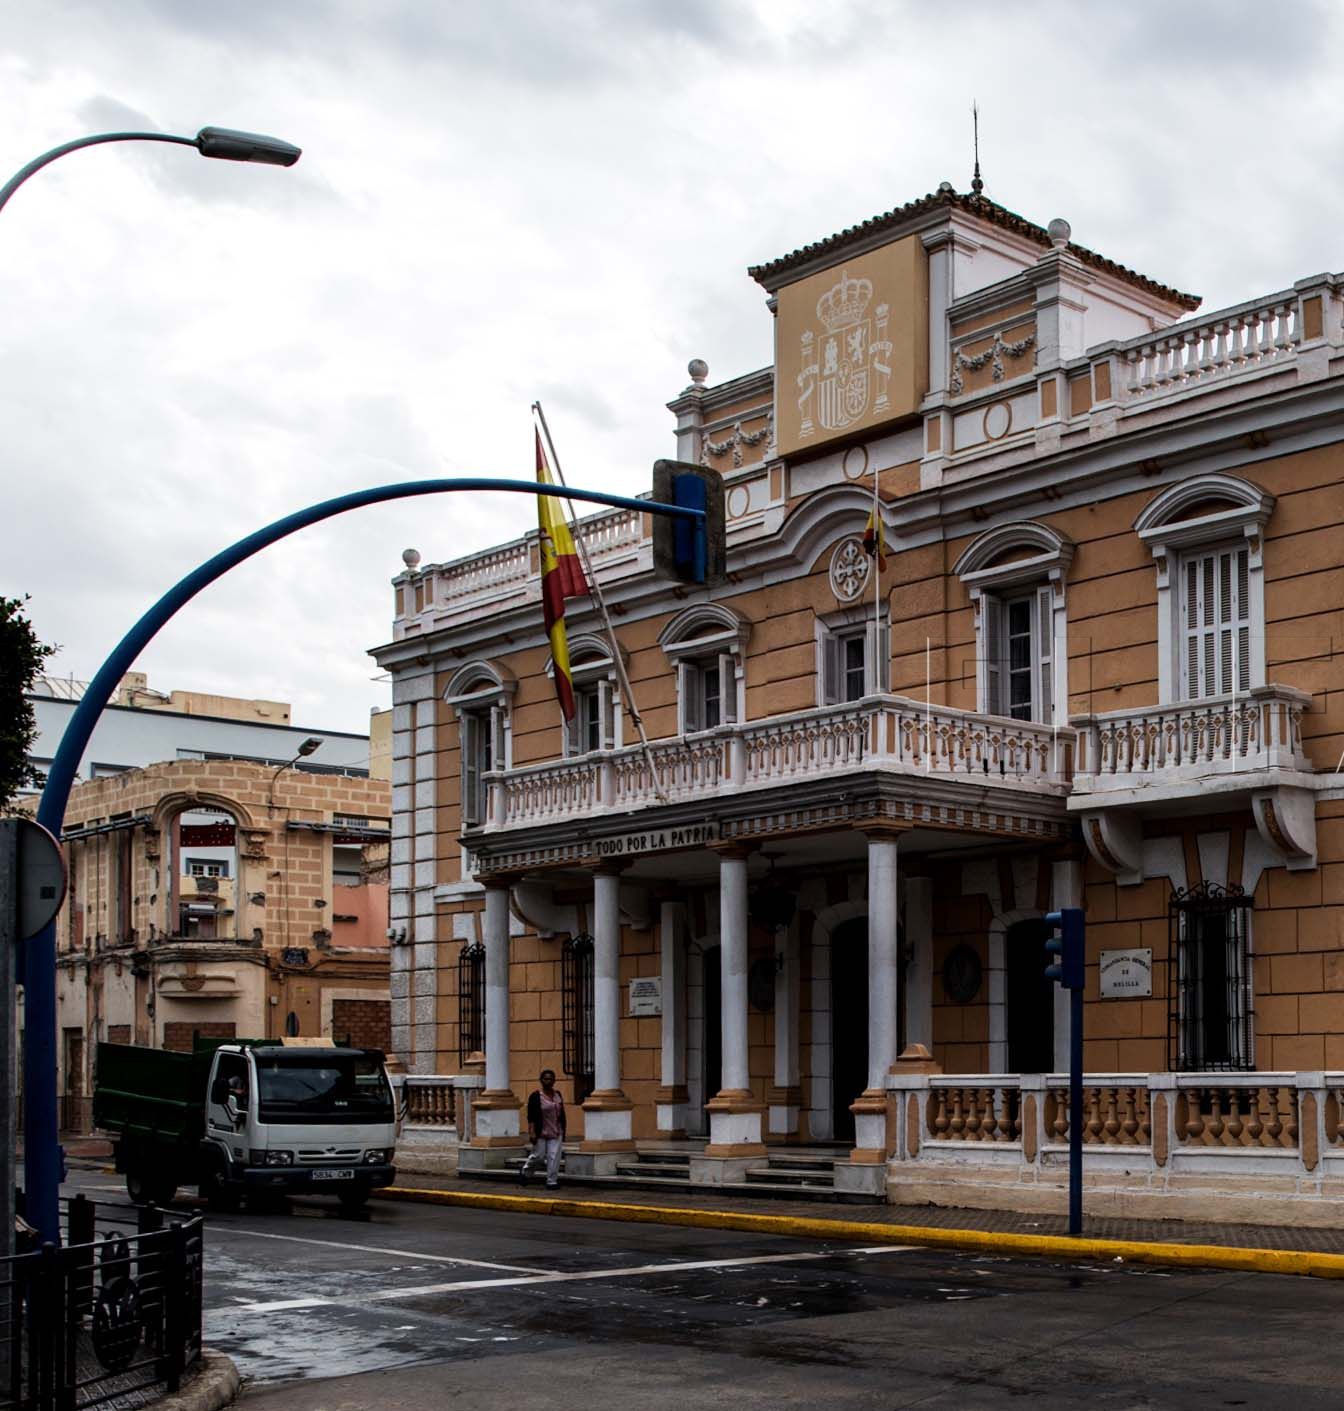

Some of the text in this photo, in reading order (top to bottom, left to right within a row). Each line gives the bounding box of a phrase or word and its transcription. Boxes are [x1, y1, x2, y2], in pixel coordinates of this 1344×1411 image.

[596, 824, 714, 855] TODO POR LA PATRIA
